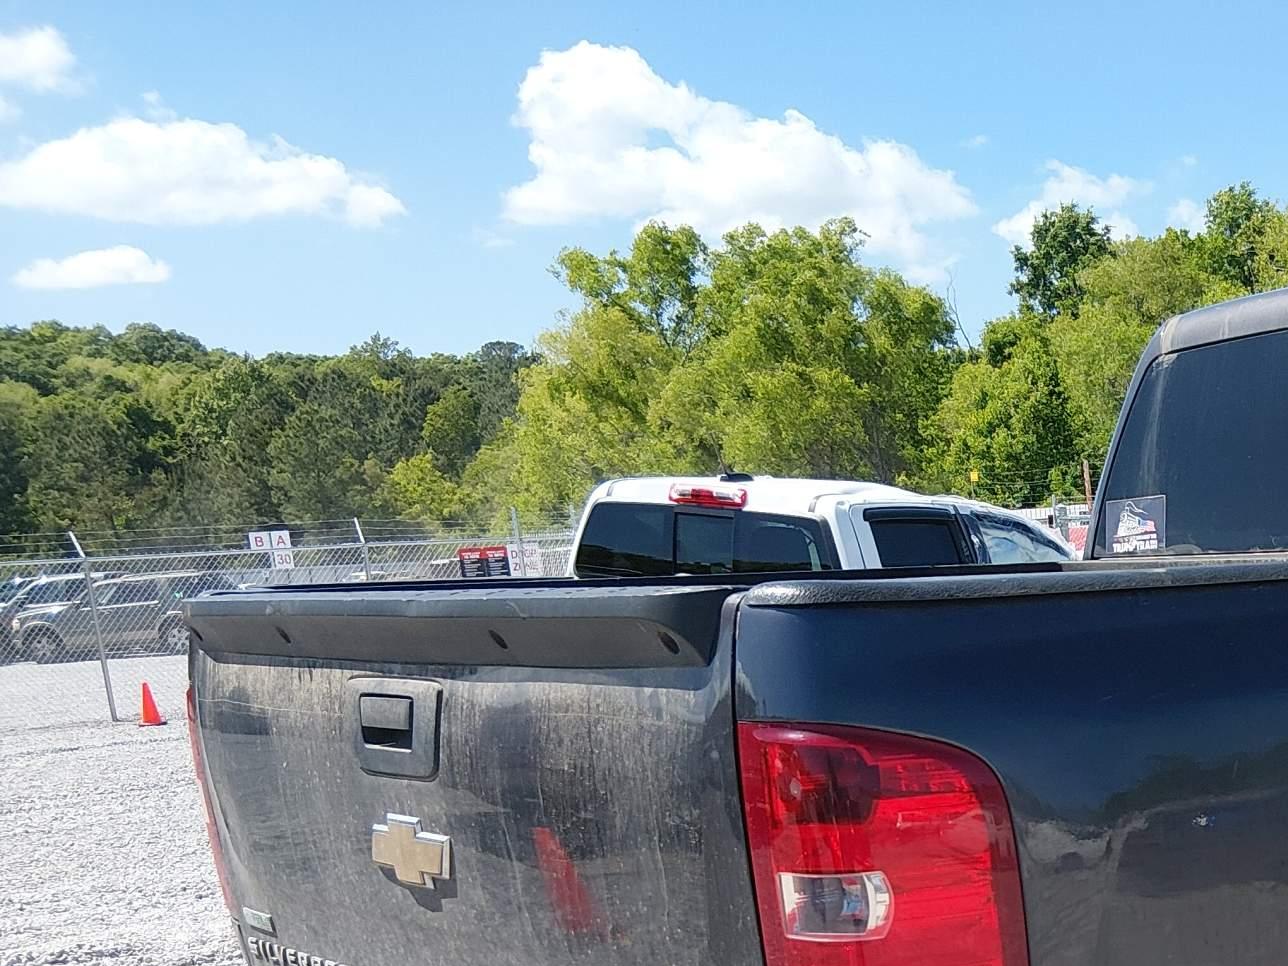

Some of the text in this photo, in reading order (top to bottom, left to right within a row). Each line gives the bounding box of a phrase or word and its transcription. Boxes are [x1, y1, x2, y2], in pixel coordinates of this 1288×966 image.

[254, 535, 287, 548] B A
[276, 553, 292, 566] 30
